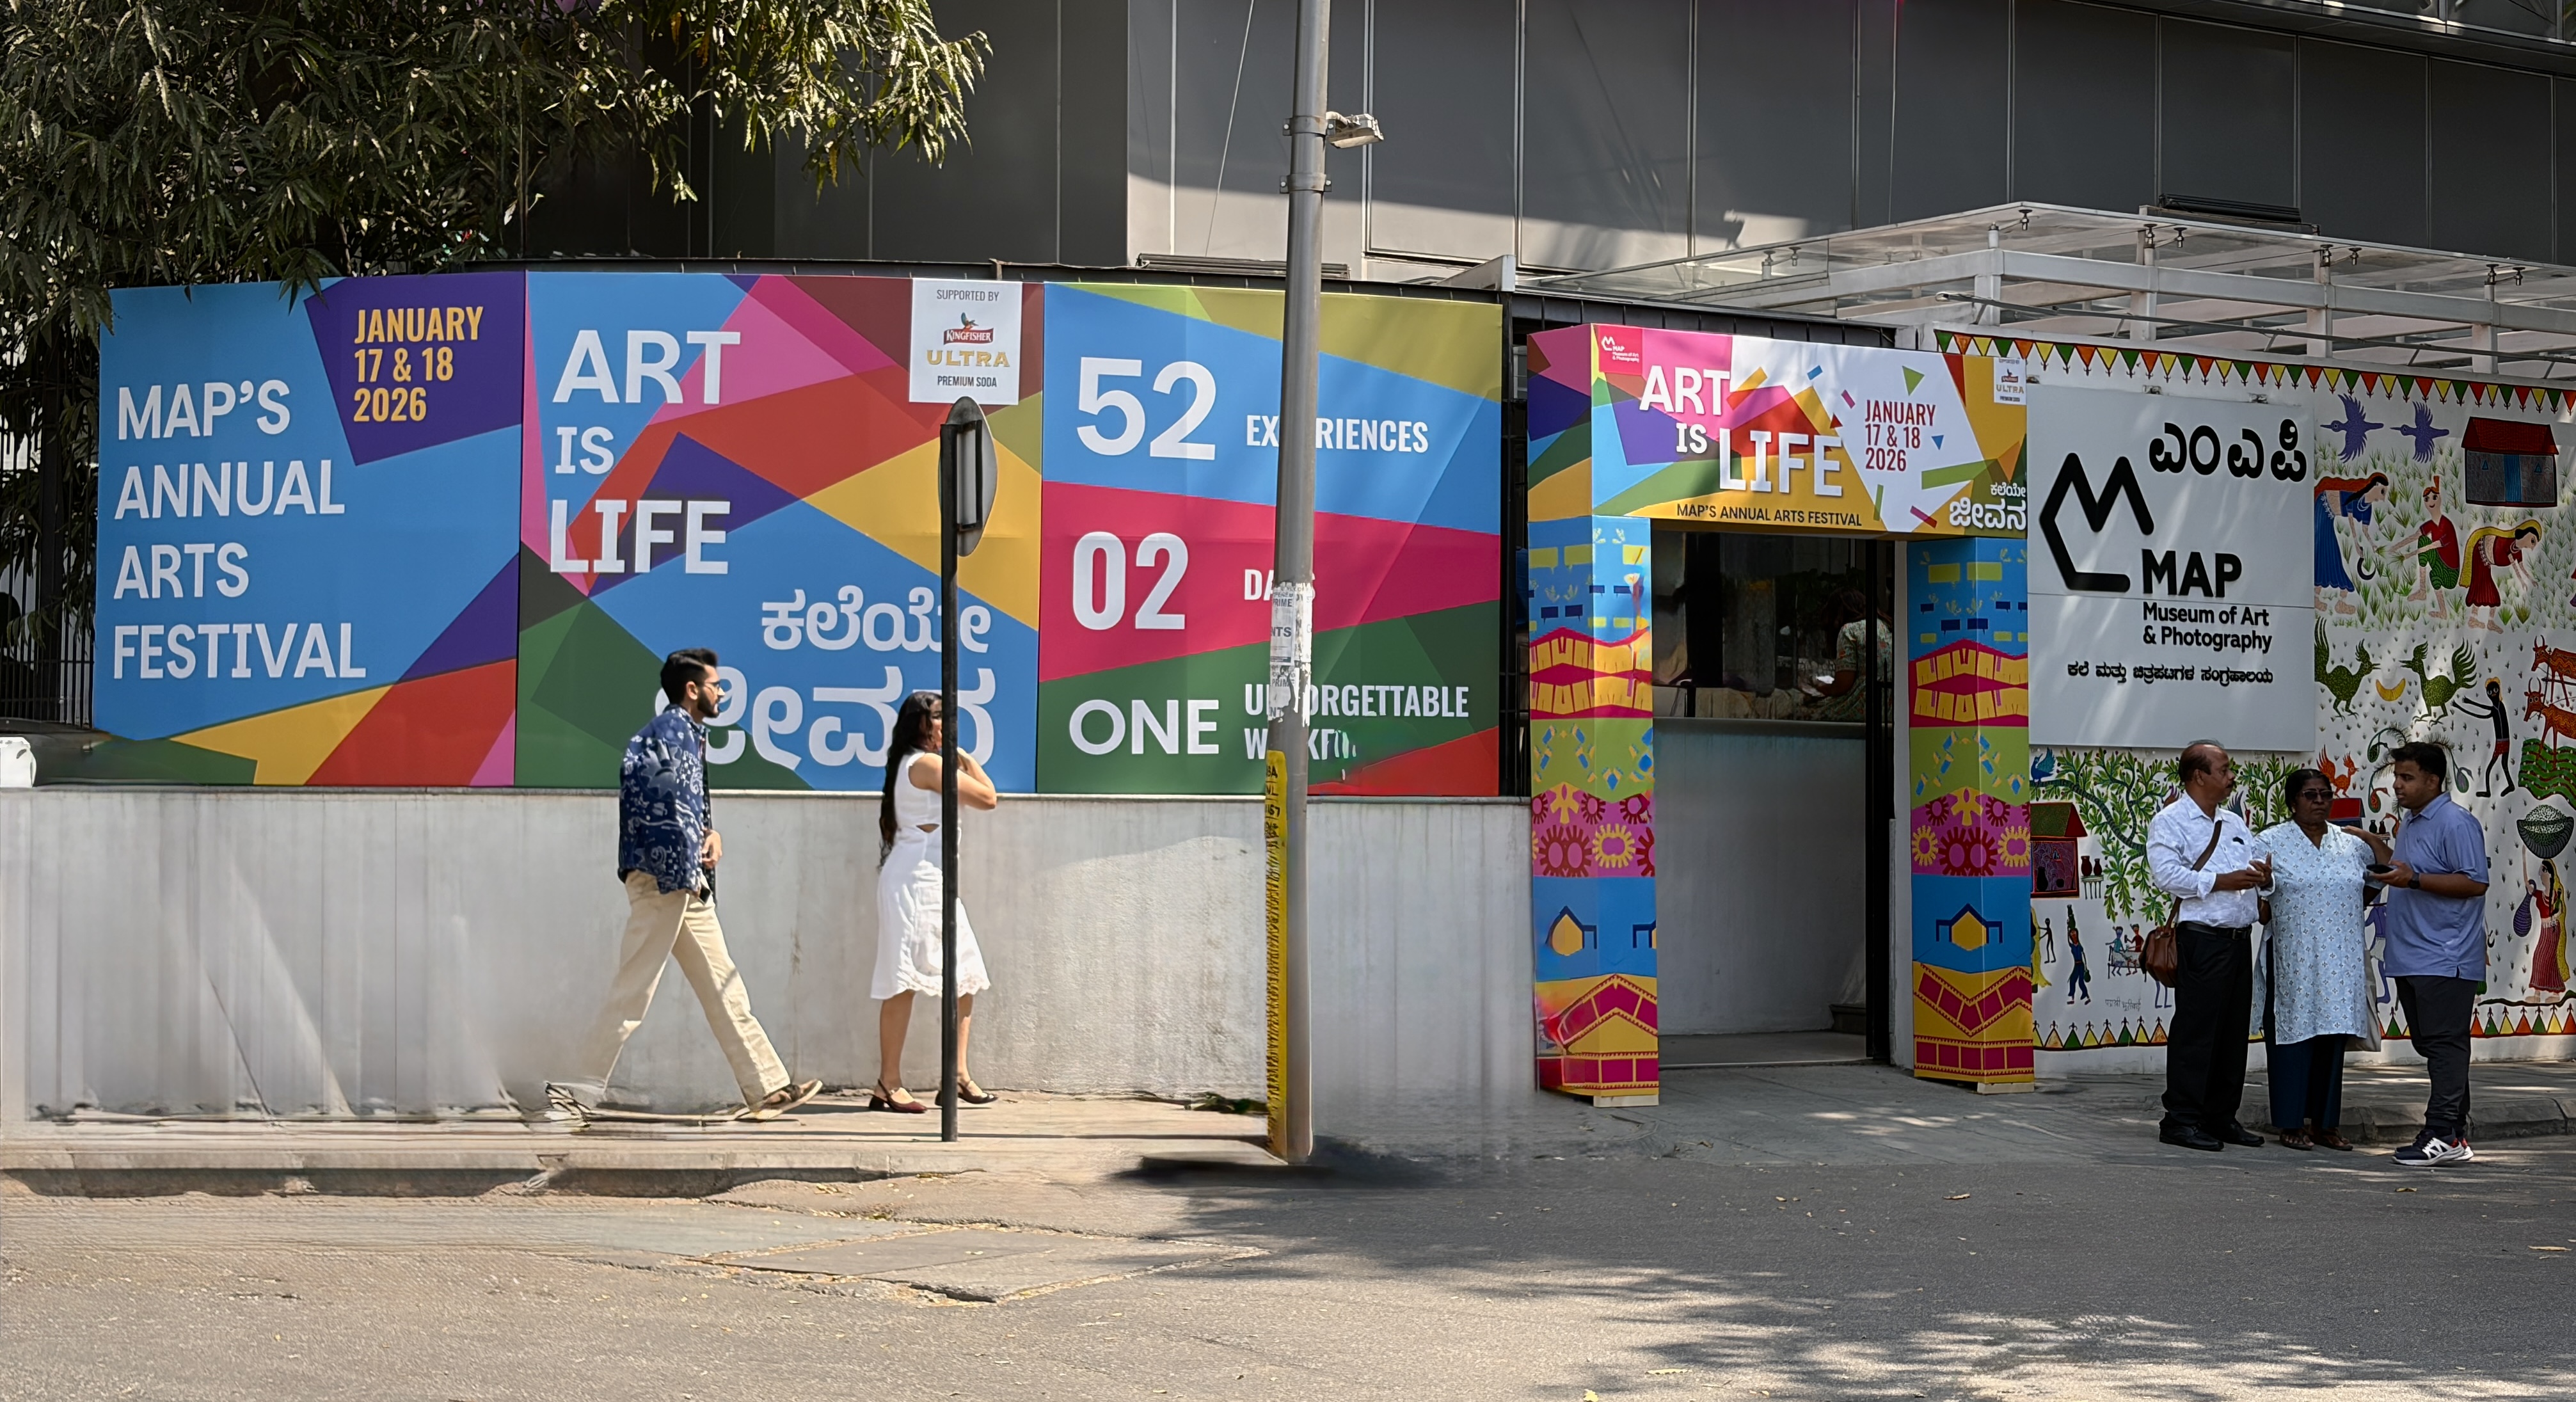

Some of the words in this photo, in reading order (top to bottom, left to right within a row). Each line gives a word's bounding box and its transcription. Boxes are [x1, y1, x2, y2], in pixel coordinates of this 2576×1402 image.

[937, 289, 985, 301] SUPPORTED
[988, 291, 999, 301] BY
[354, 306, 484, 344] JANUARY
[946, 330, 992, 342] KINGFISHER
[354, 349, 383, 383] 17
[393, 349, 412, 382] &
[421, 347, 454, 381] 18
[552, 330, 741, 405] ART
[926, 350, 1010, 367] ULTRA
[937, 376, 974, 386] PREMIUM
[976, 377, 997, 387] SODA
[1639, 365, 1730, 415] ART
[1996, 384, 2024, 394] ULTRA
[118, 379, 290, 440] MAP'S
[353, 387, 427, 422] 2026
[1077, 356, 1216, 461] 52
[1865, 399, 1936, 426] JANUARY
[555, 426, 615, 475] IS
[1247, 415, 1429, 453] EXRIENCES
[1676, 422, 1707, 454] IS
[1865, 424, 1880, 445] 17
[1887, 425, 1897, 447] &
[1904, 426, 1920, 449] 18
[1719, 427, 1842, 497] LIFE
[1865, 447, 1906, 472] 2026
[114, 459, 345, 520] ANNUAL
[1990, 482, 2026, 497] ಕಲೆಯೇ
[1677, 504, 1716, 518] MAP'S
[1720, 506, 1771, 521] ANNUAL
[1774, 509, 1804, 523] ARTS
[1808, 511, 1862, 527] FESTIVAL
[1950, 497, 2026, 530] ಜೀವನ
[550, 499, 731, 575] LIFE
[113, 542, 249, 600] ARTS
[1072, 531, 1189, 630] 02
[2142, 548, 2242, 598] MAP
[2143, 601, 2214, 623] Museum
[2219, 606, 2237, 625] of
[2241, 607, 2269, 626] Art
[113, 623, 367, 679] FESTIVAL
[2143, 625, 2156, 644] &
[2161, 626, 2272, 654] Photography
[2067, 661, 2089, 676] ಕಲೆ
[2095, 662, 2127, 683] ಮತ್ತು
[1245, 684, 1469, 717] UORGETTABLE
[1069, 699, 1220, 755] ONE
